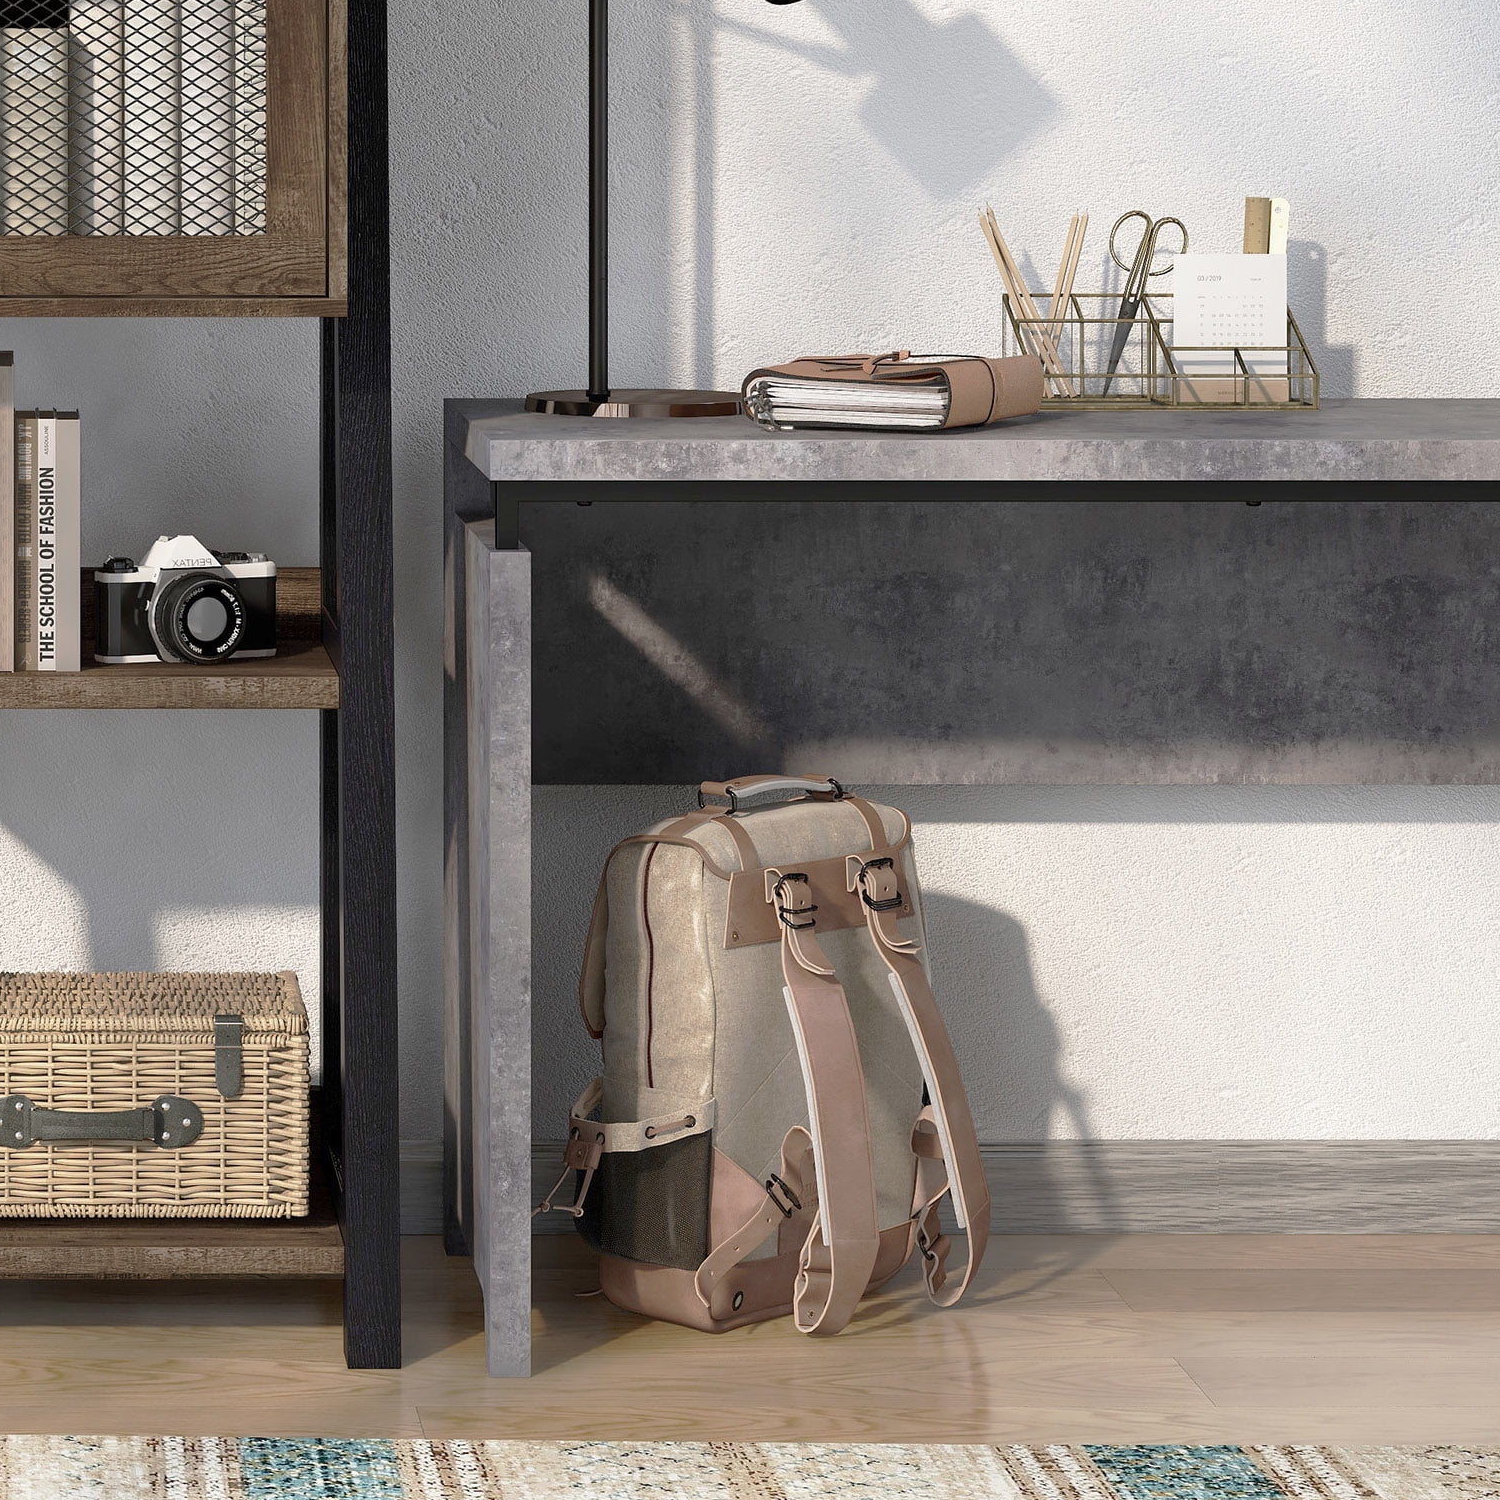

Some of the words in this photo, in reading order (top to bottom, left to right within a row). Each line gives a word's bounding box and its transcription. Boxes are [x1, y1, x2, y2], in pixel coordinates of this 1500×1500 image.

[18, 443, 32, 480] ROWLING
[18, 484, 32, 511] HARRY
[39, 467, 55, 535] FASHION
[18, 513, 32, 544] POTTER
[39, 539, 55, 560] OF
[18, 560, 32, 599] CHAMBER
[39, 563, 55, 627] SCHOOL
[39, 631, 55, 662] THE
